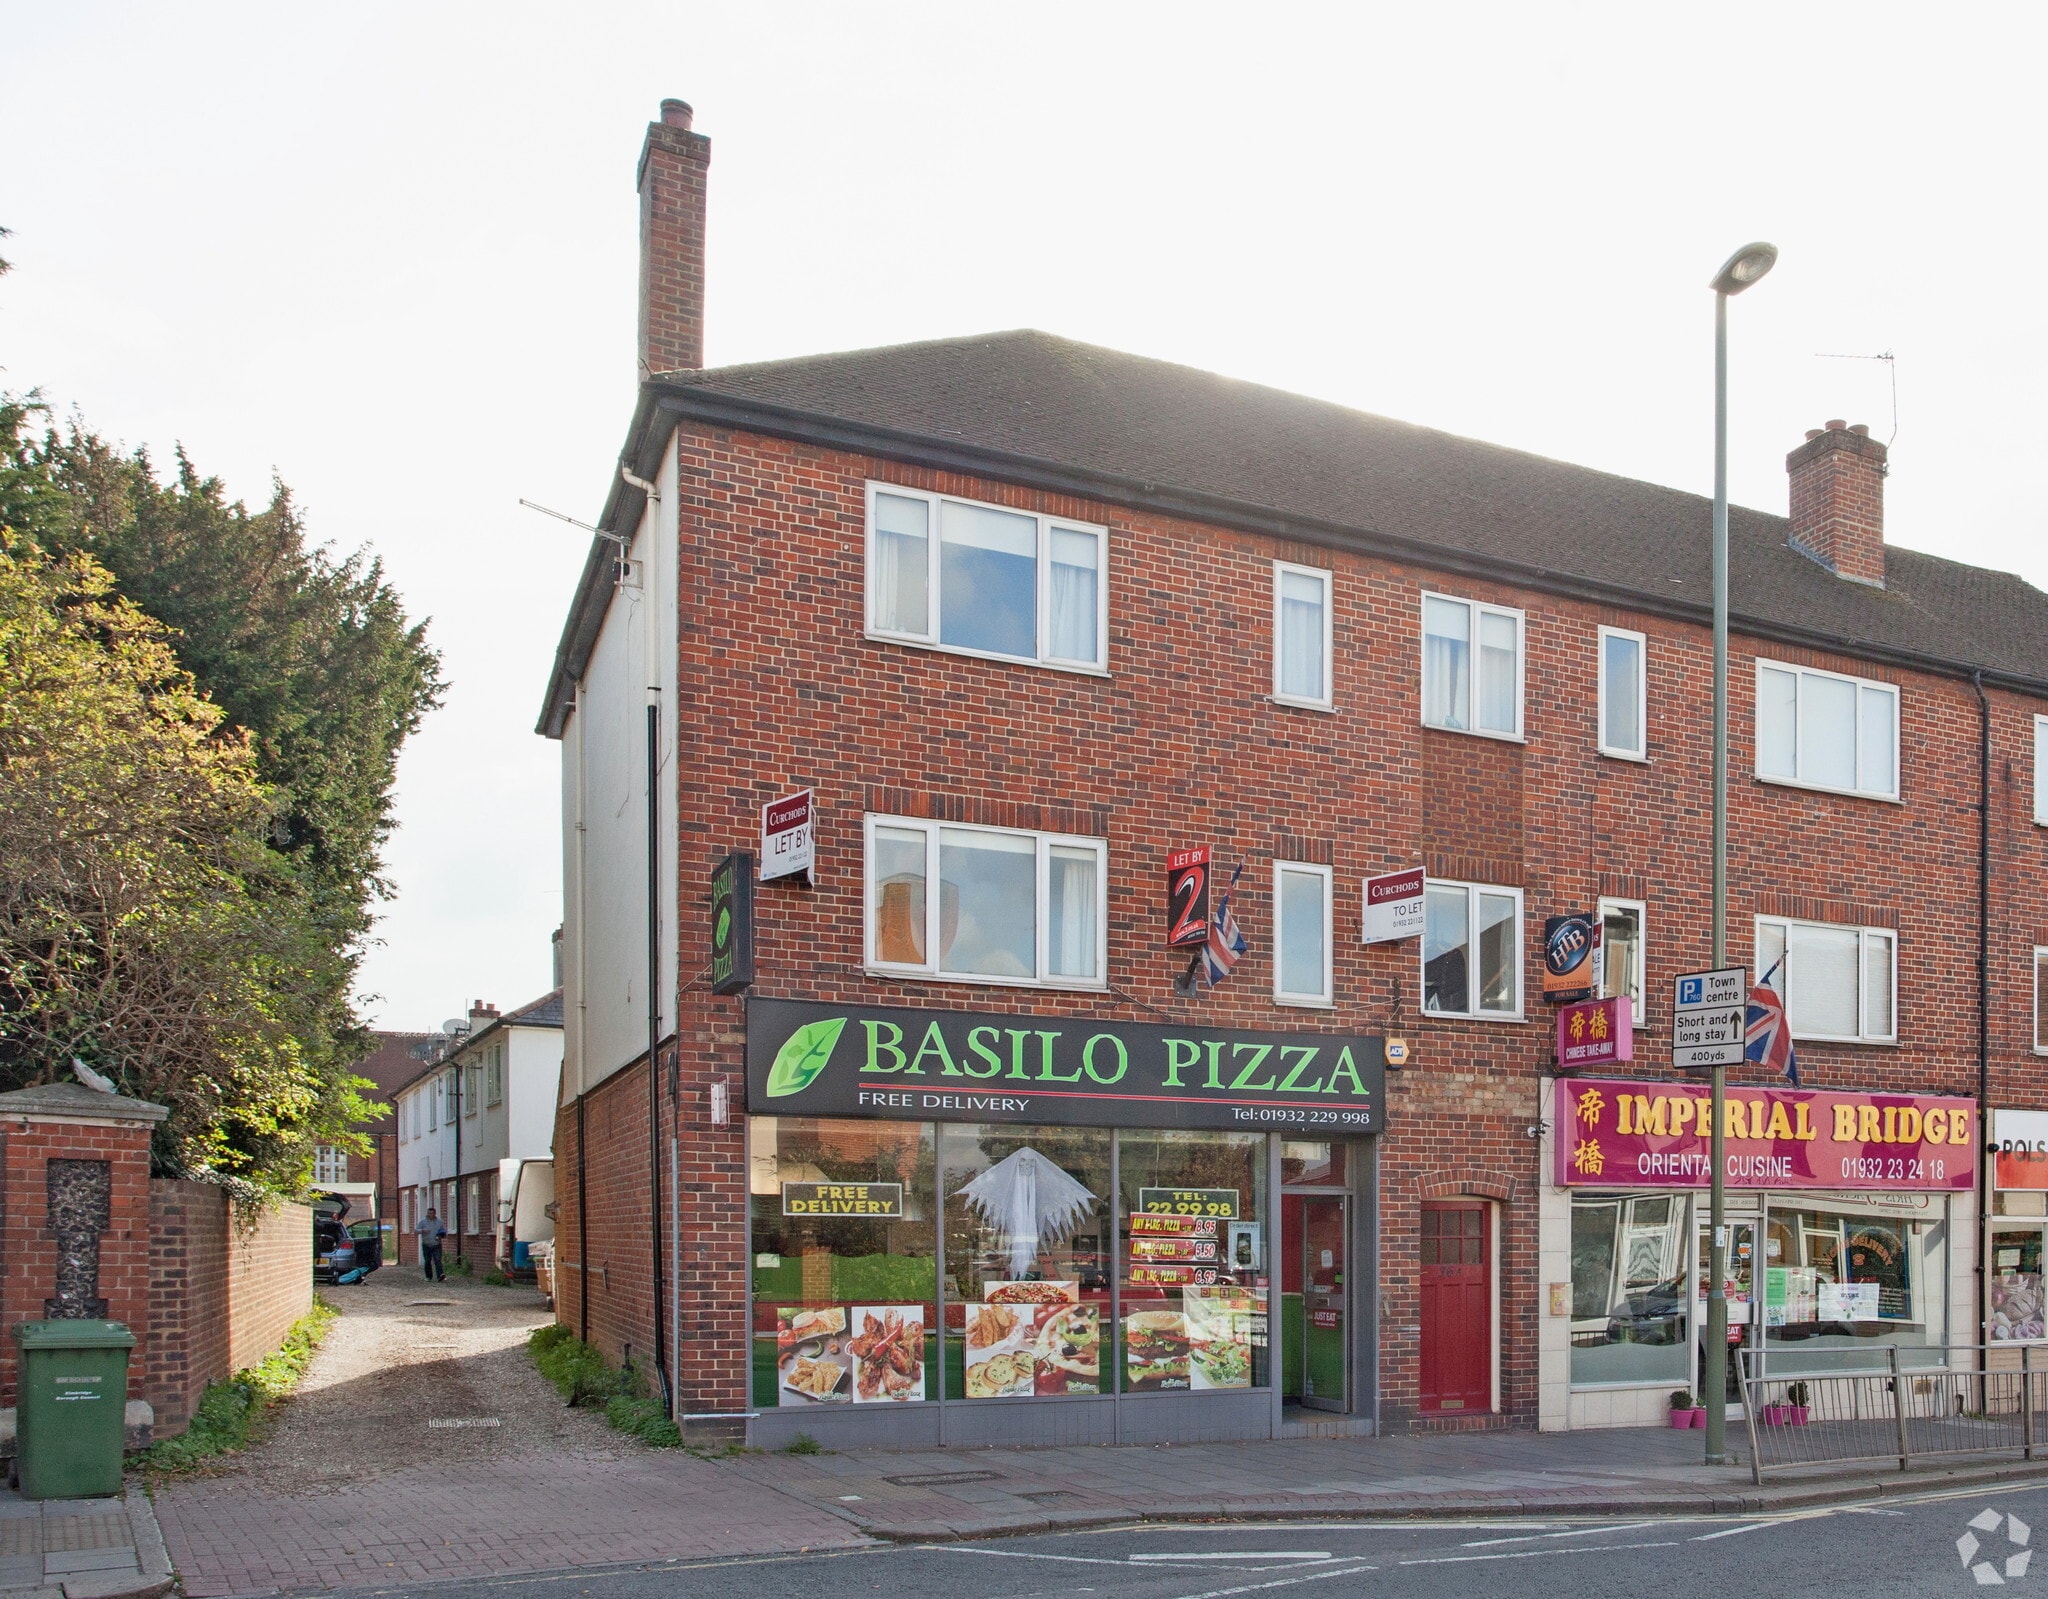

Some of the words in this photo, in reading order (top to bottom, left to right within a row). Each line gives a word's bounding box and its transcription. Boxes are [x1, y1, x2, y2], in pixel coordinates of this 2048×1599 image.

[775, 832, 794, 855] LET
[796, 826, 809, 848] BY
[1174, 853, 1190, 867] LET
[1191, 849, 1203, 863] BY
[713, 866, 733, 912] BASILO
[1393, 905, 1407, 917] TO
[1408, 901, 1424, 915] LET
[1551, 929, 1586, 969] HTB
[713, 945, 733, 985] PIZZA
[1709, 977, 1736, 989] Town
[1683, 981, 1695, 1002] P
[1706, 991, 1739, 1003] centre
[1677, 1015, 1705, 1028] Short
[1709, 1013, 1728, 1026] and
[1679, 1031, 1701, 1043] long
[1704, 1029, 1726, 1041] stay
[859, 1019, 1128, 1085] BASILO
[1161, 1038, 1370, 1095] PIZZA
[1390, 1046, 1403, 1056] ADT
[1565, 1045, 1586, 1060] CHINESE
[1586, 1041, 1614, 1057] TAKE-AWAY
[858, 1092, 913, 1107] FREE
[923, 1094, 1030, 1111] DELIVERY
[1309, 1111, 1338, 1123] 229
[1341, 1111, 1370, 1124] 998
[1615, 1093, 1817, 1142] IMPERIAL
[1831, 1103, 1970, 1146] BRIDGE
[2002, 1139, 2047, 1162] POLS
[1637, 1152, 1712, 1176] ORIENTA
[1726, 1154, 1792, 1178] CUISINE
[1841, 1156, 1883, 1179] 01932
[1887, 1157, 1904, 1179] 23
[1908, 1158, 1924, 1180] 24
[1929, 1159, 1945, 1180] 18
[816, 1186, 869, 1199] FREE
[1172, 1192, 1208, 1201] TEL:
[791, 1199, 894, 1213] DELIVERY
[1147, 1201, 1173, 1214] 22
[1176, 1202, 1203, 1216] 99
[1206, 1202, 1232, 1217] 98
[1132, 1217, 1145, 1230] ANY
[1163, 1218, 1181, 1232] PIZZA
[1194, 1219, 1216, 1234] 8.95
[1195, 1243, 1216, 1258] 5.50
[1132, 1269, 1145, 1282] ANY
[1160, 1269, 1177, 1282] PIZZA
[1194, 1269, 1216, 1285] 6.95
[1313, 1311, 1326, 1321] JUST
[1326, 1312, 1337, 1322] EAT
